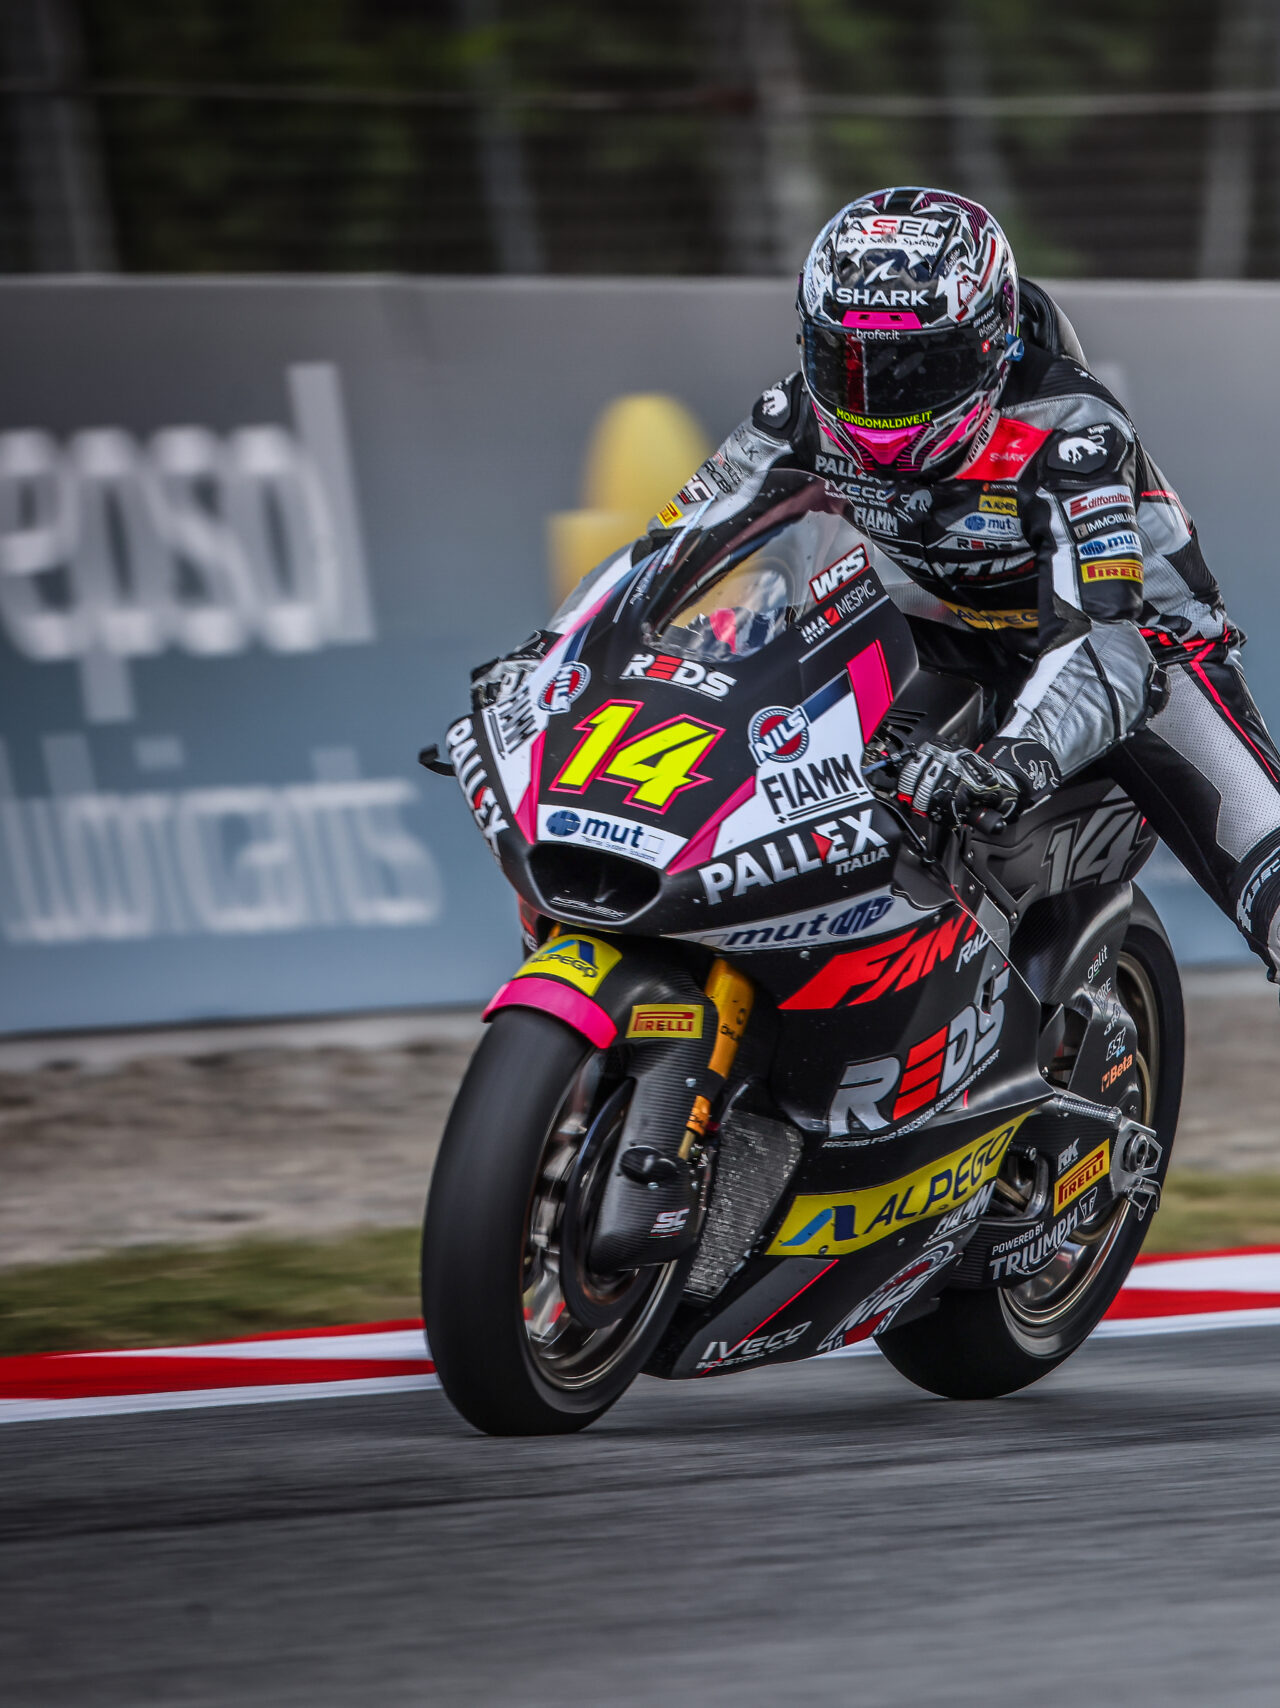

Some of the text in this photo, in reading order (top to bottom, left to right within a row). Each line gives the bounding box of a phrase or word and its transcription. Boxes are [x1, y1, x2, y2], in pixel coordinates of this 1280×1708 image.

[836, 288, 929, 307] SHARK
[856, 328, 900, 342] brofer.it
[836, 407, 933, 430] MONDOMALDIVE.IT
[989, 452, 1028, 463] SHARK
[824, 480, 896, 503] IVECO
[853, 506, 899, 533] FIAMM
[988, 518, 1012, 530] mut
[1107, 533, 1138, 548] mut
[811, 548, 868, 601] WRS
[835, 578, 876, 619] MESPIC
[620, 653, 738, 699] REDS
[752, 708, 808, 763] NILS
[550, 699, 725, 814] 14
[446, 717, 510, 860] PALLEX
[761, 754, 863, 815] FIAMM
[582, 817, 644, 848] mut
[1044, 800, 1146, 895] 14
[698, 808, 889, 906] PALLEX
[835, 847, 890, 876] ITALIA
[725, 912, 829, 945] mut
[1087, 944, 1108, 984] gelit
[632, 1011, 696, 1033] PIRELLI
[828, 967, 1011, 1138] REDS
[1110, 1053, 1134, 1084] Beta
[1058, 1137, 1080, 1173] RK
[862, 1126, 1015, 1235] ALPEGO
[1058, 1150, 1105, 1206] PIRELLI
[653, 1208, 690, 1228] SC
[989, 1209, 1078, 1282] TRIUMPH
[992, 1221, 1045, 1255] POWERED BY
[701, 1320, 812, 1360] IVECO
